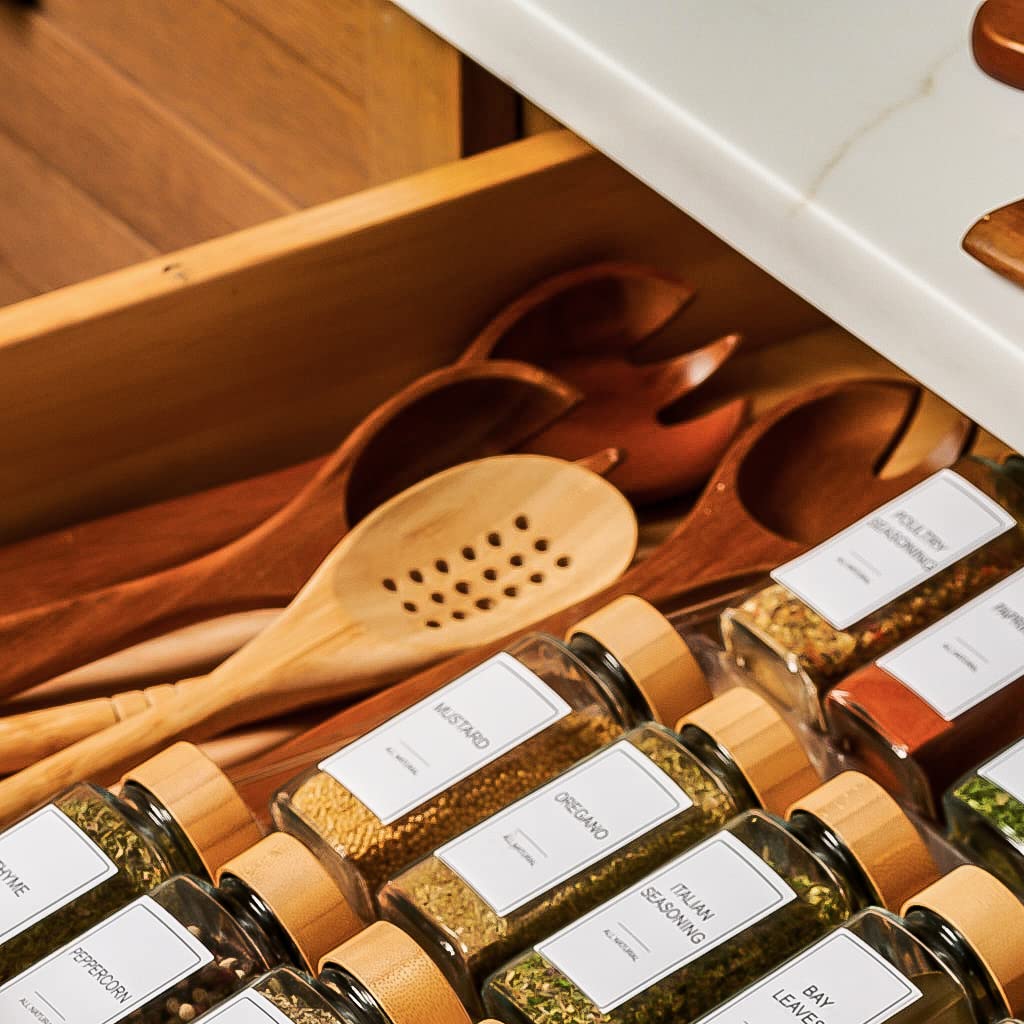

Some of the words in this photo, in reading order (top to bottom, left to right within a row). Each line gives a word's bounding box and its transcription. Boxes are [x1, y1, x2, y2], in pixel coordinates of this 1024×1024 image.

[433, 702, 490, 750] MUSTARD
[554, 791, 609, 840] OREGANO
[0, 857, 30, 897] HYME
[639, 887, 706, 945] SEASONING
[670, 883, 716, 922] ITALIAN
[69, 947, 133, 1004] PEPPERCORN
[802, 984, 835, 1009] BAY
